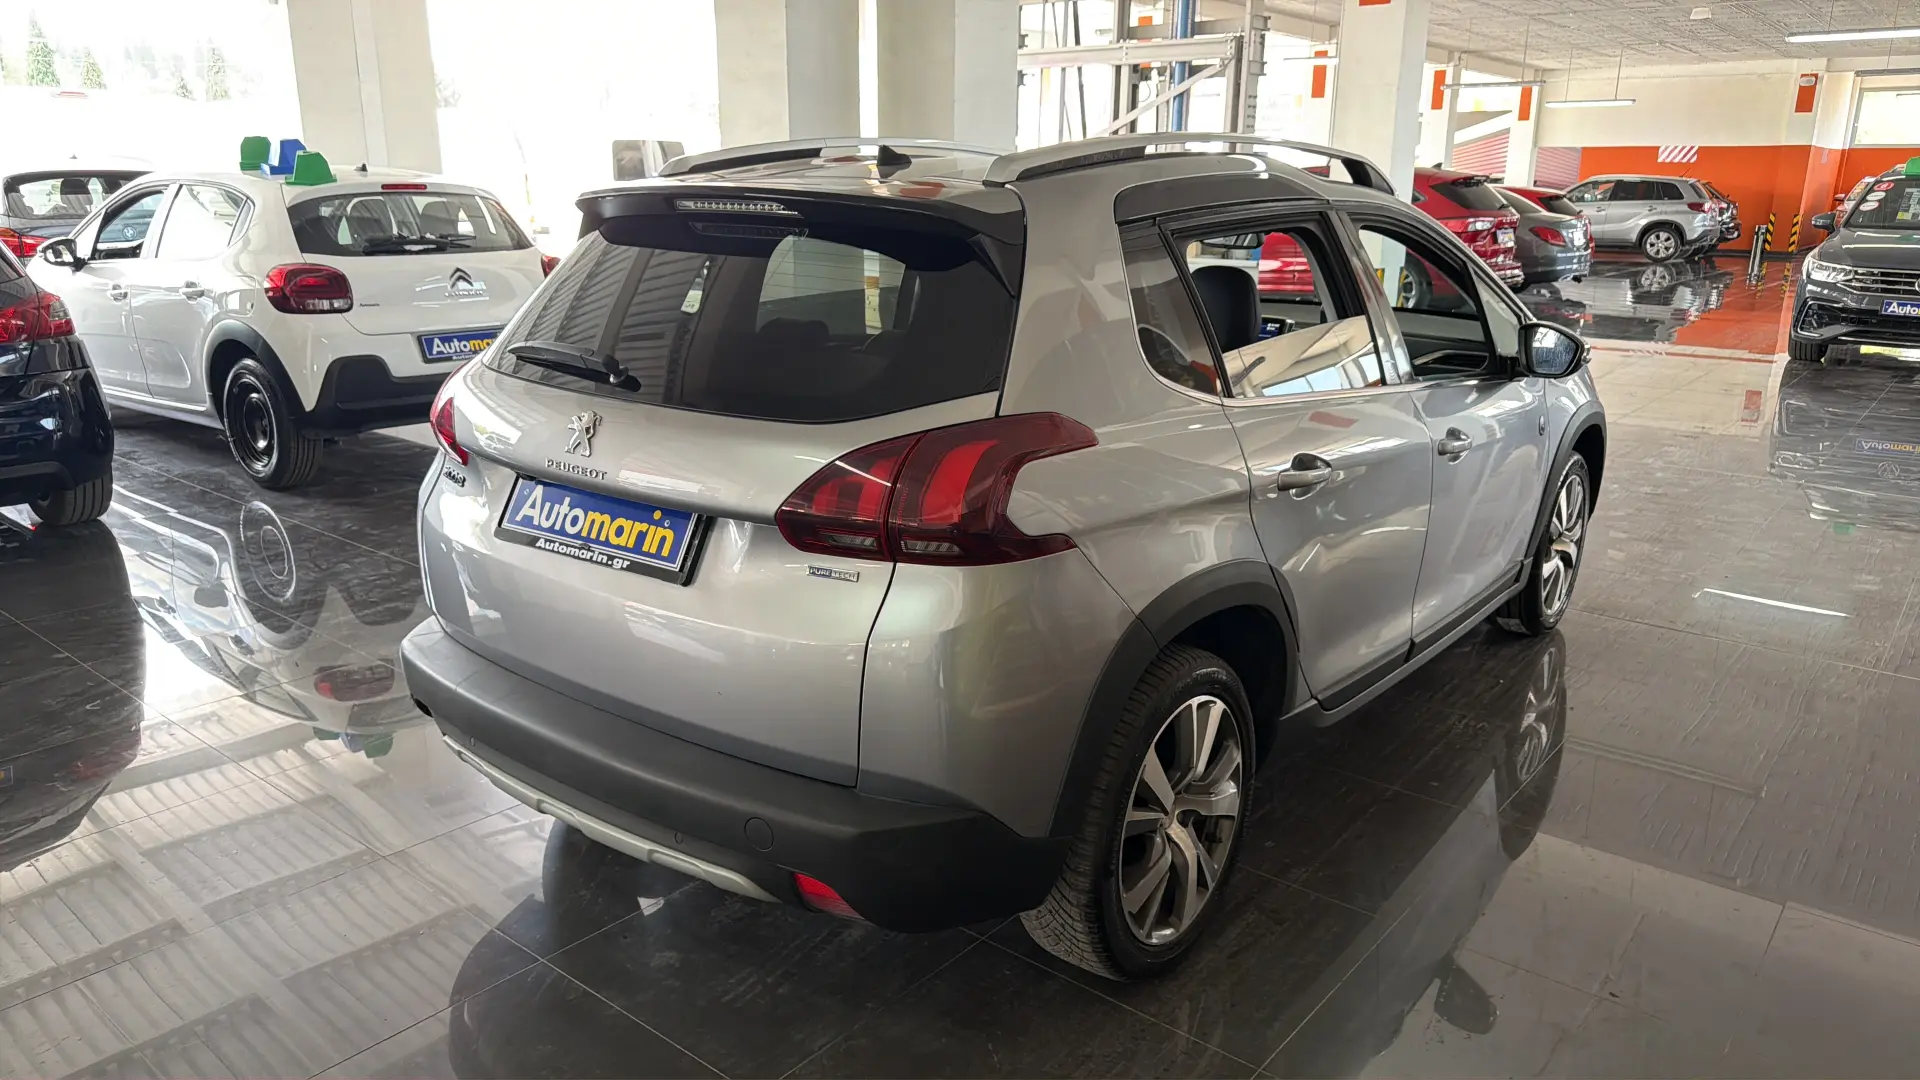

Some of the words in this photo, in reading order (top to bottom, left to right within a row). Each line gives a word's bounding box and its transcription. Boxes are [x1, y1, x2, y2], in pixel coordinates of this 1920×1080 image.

[1887, 301, 1920, 315] Auto
[545, 457, 608, 481] PEUGEOT
[514, 484, 675, 558] Automarin
[534, 537, 631, 570] Automarin.gr
